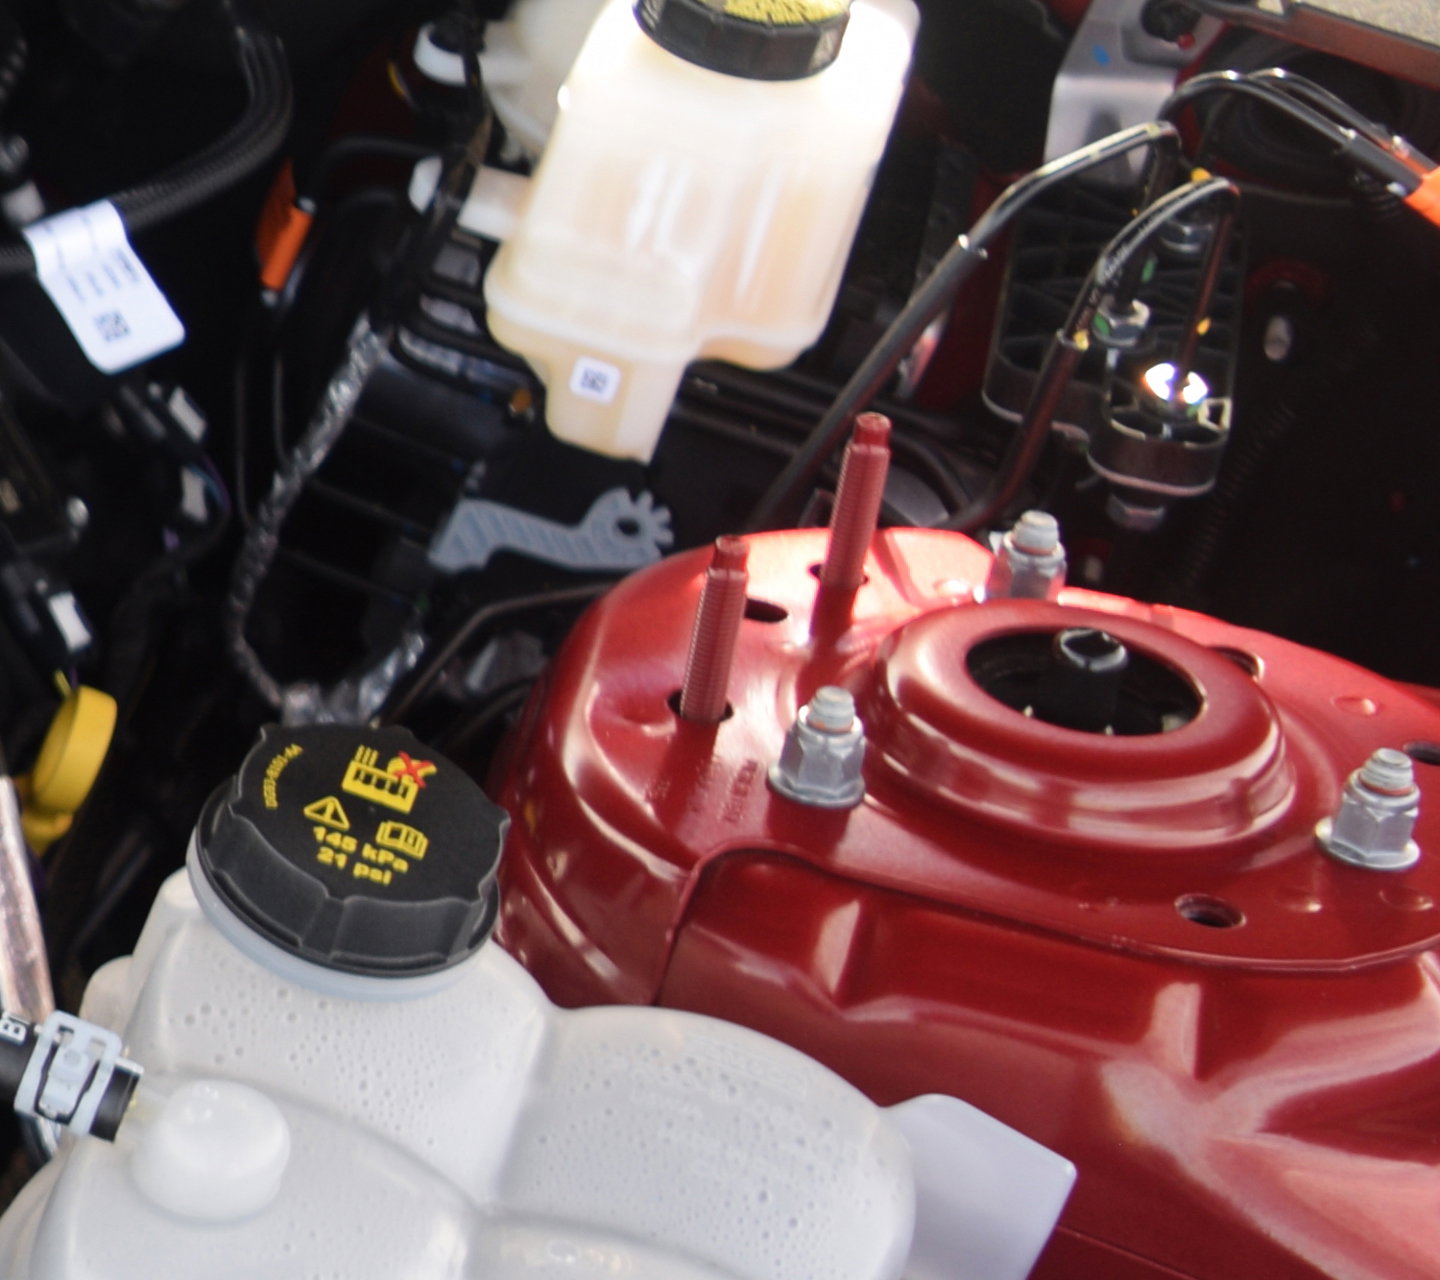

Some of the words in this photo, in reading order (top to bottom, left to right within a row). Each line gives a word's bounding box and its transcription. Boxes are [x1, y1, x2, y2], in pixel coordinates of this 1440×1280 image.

[313, 825, 358, 854] 145
[362, 842, 409, 874] kPa
[317, 846, 347, 869] 21
[353, 861, 392, 886] psi
